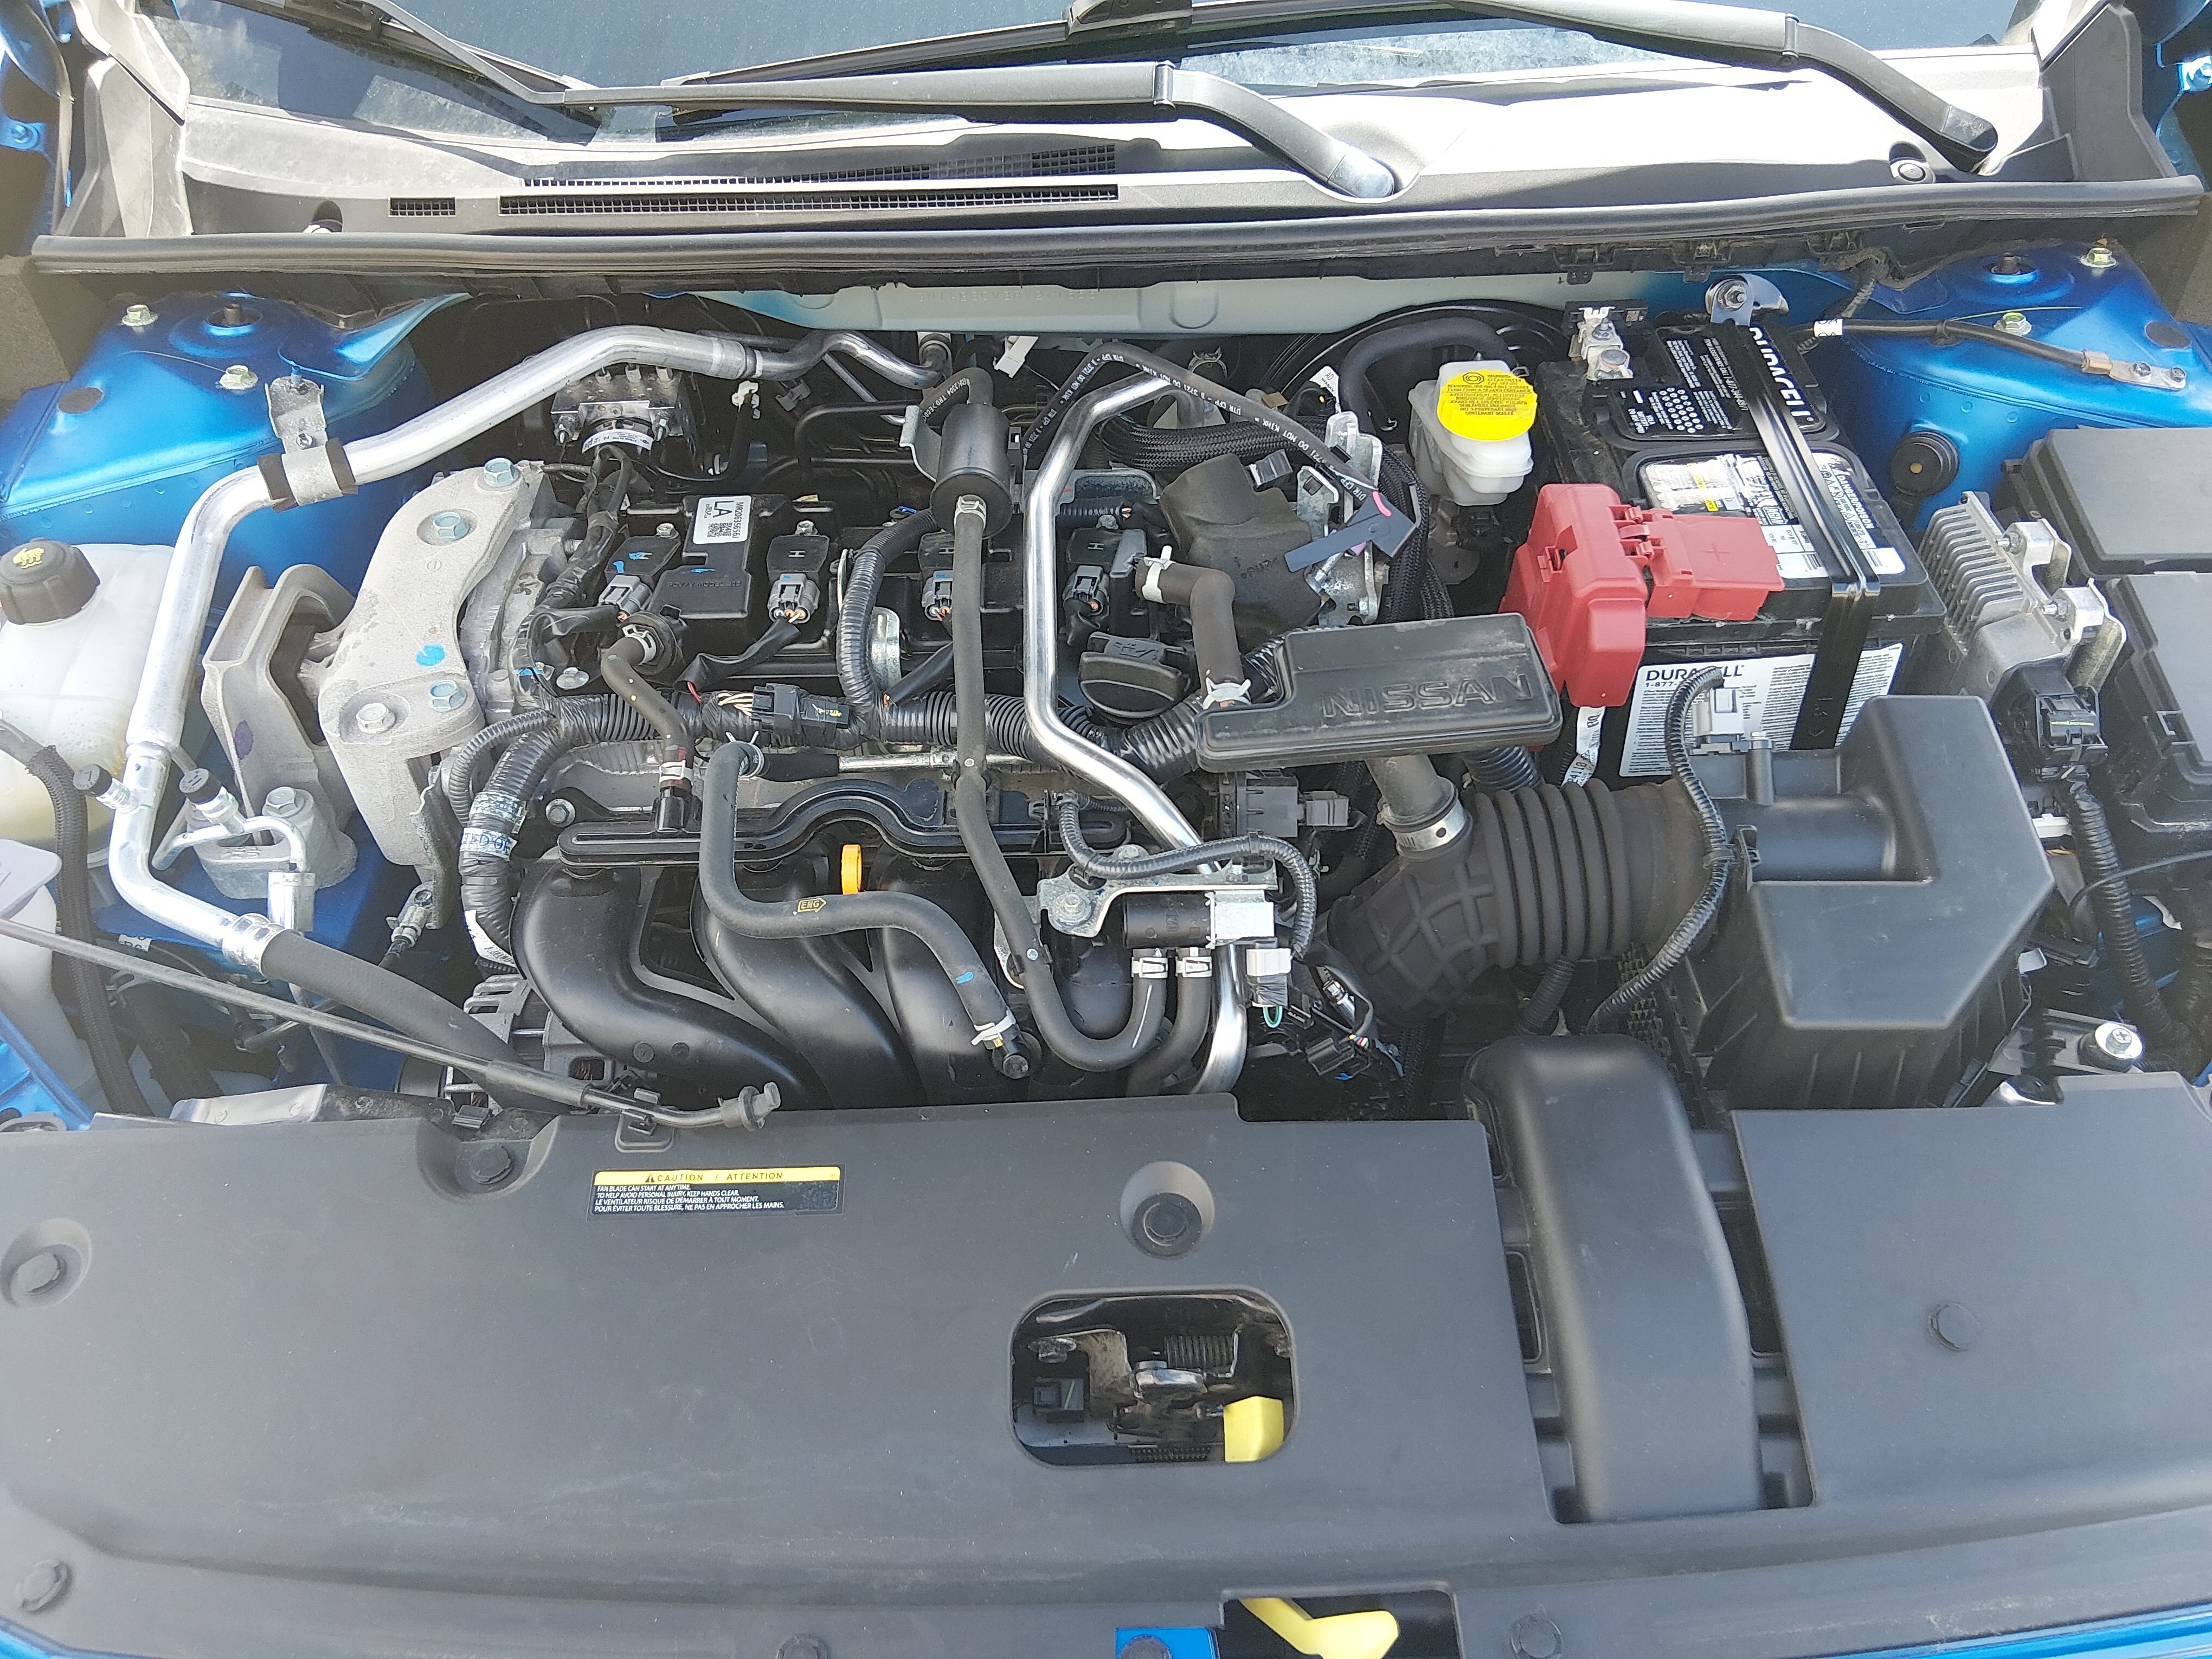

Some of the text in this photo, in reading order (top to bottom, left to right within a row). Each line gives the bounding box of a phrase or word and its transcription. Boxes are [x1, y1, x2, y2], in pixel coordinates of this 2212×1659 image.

[1282, 428, 1298, 443] NOT
[1352, 486, 1367, 501] DTR
[712, 500, 734, 518] LA
[1767, 507, 1784, 524] AGM
[1321, 674, 1532, 718] NISSAN
[801, 901, 820, 909] ENG
[726, 1172, 782, 1180] ATTENTION
